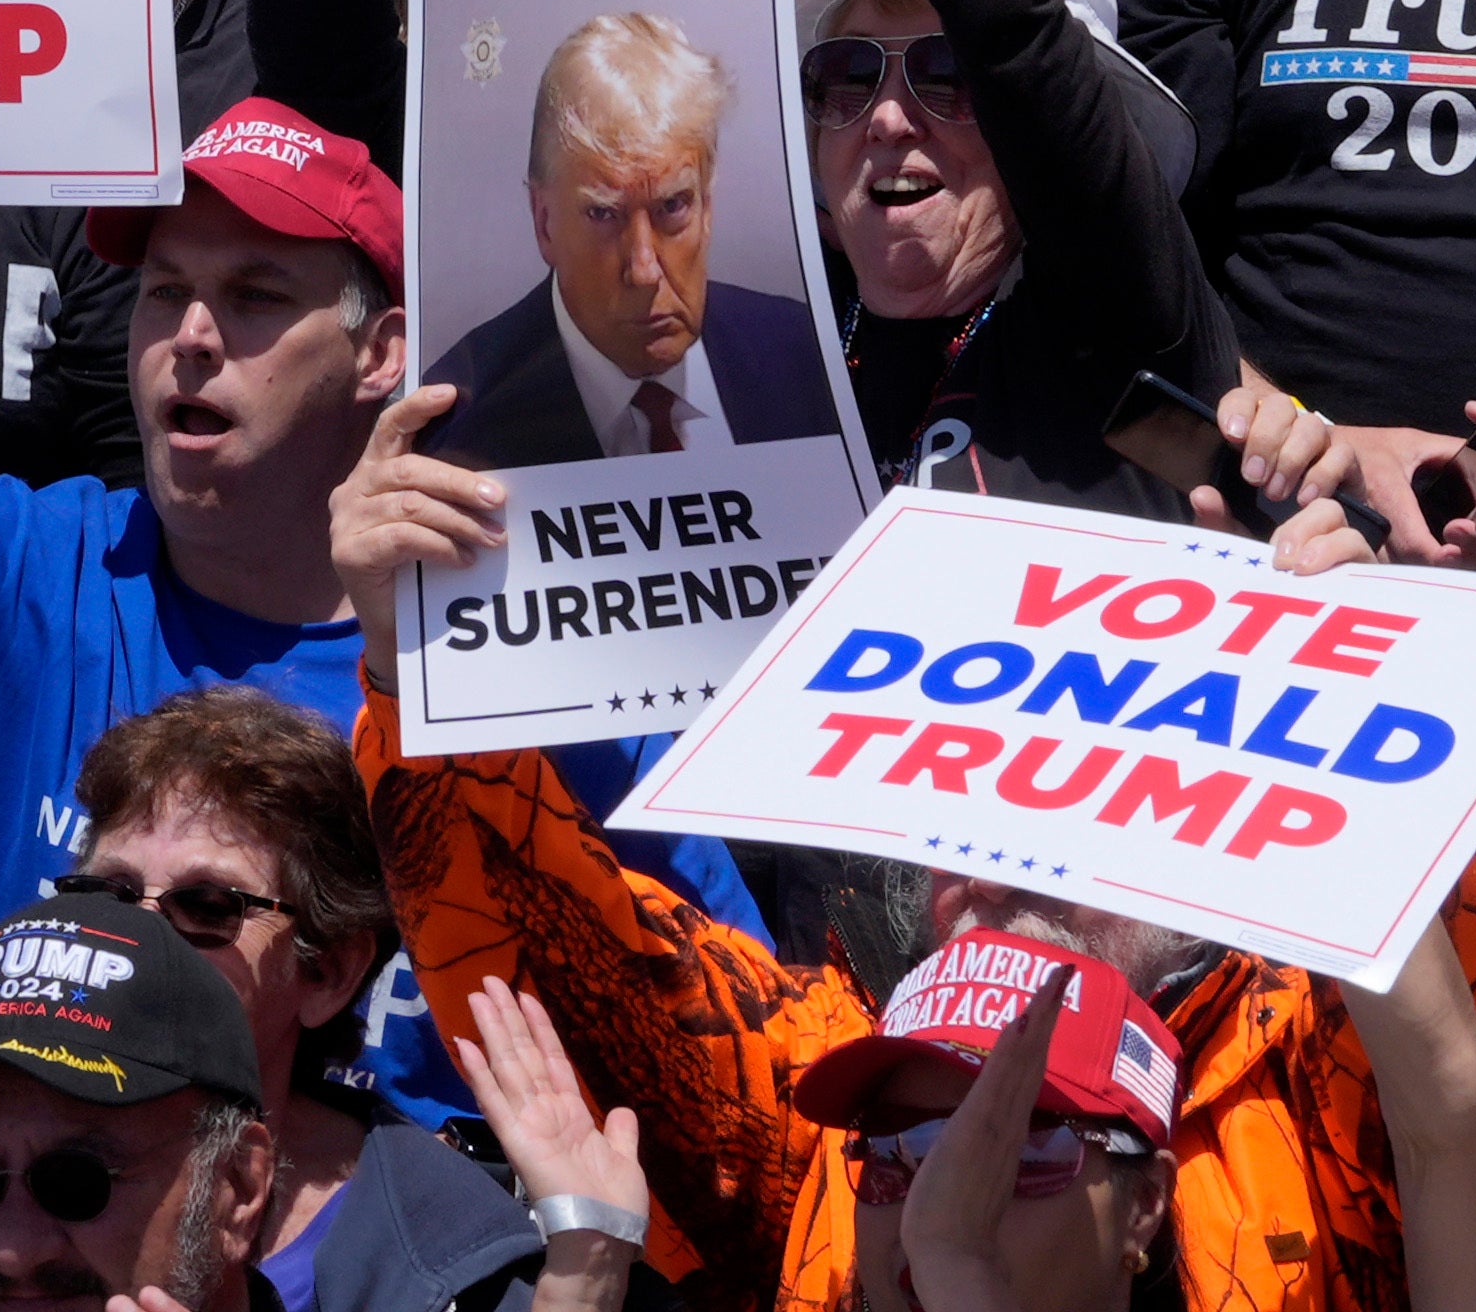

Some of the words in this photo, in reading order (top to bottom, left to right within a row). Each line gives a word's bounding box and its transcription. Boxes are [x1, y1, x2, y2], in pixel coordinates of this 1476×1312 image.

[220, 121, 326, 155] AMERICA
[226, 137, 311, 173] AGAIN
[531, 489, 761, 565] NEVER
[445, 555, 840, 655] SURRENDE
[1015, 563, 1421, 678] VOTE
[805, 628, 1457, 785] DONALD
[806, 712, 1348, 862] TRUMP
[54, 1005, 112, 1032] AGAIN
[882, 986, 956, 1038] GREAT
